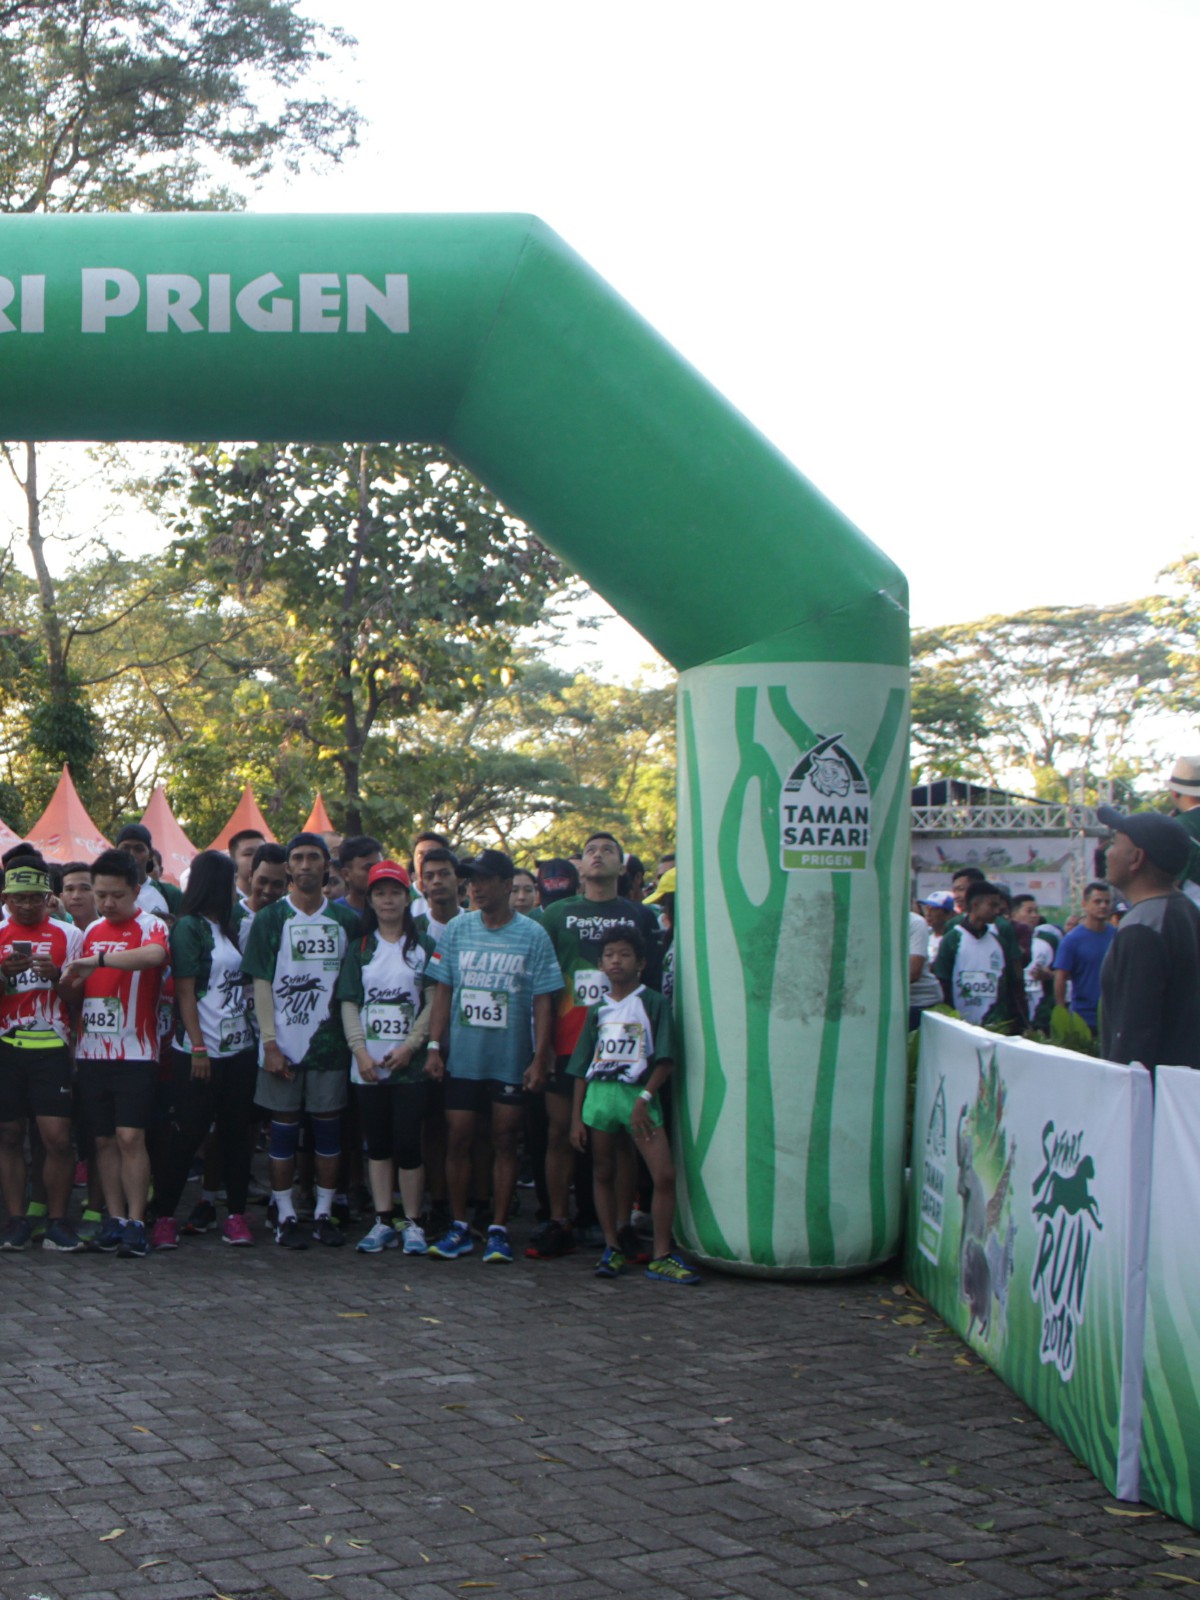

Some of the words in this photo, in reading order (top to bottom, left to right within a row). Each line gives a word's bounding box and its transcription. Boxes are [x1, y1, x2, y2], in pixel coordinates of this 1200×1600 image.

[80, 266, 410, 334] PRIGEN
[784, 805, 868, 824] TAMAN
[783, 827, 867, 846] SAFARI
[801, 853, 853, 867] PRIGEN
[296, 939, 336, 954] 0233
[275, 973, 312, 994] SAFARI
[280, 990, 321, 1015] RUN
[365, 986, 403, 1005] SAFARI
[83, 1012, 116, 1027] 0482
[286, 1011, 310, 1026] 2018
[464, 1004, 503, 1021] 0163
[372, 1019, 410, 1035] 0232
[598, 1038, 637, 1055] 0077
[1033, 1212, 1091, 1313] RUN
[1042, 1303, 1073, 1372] 2018
